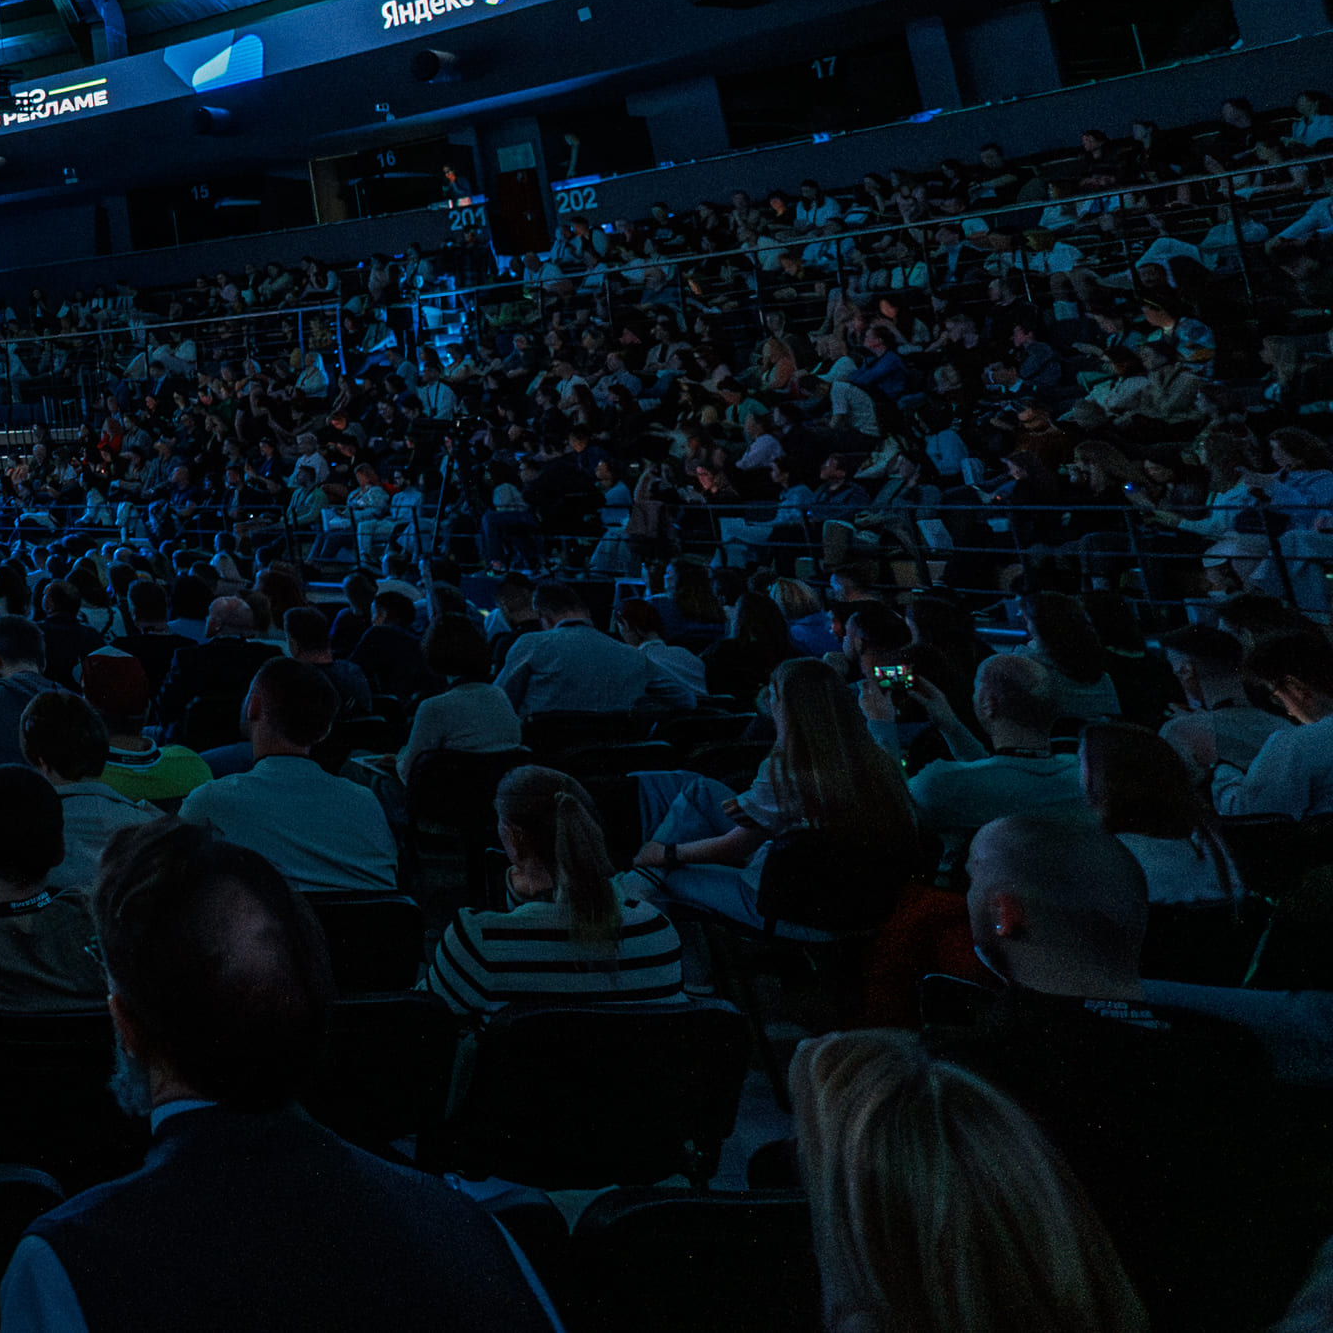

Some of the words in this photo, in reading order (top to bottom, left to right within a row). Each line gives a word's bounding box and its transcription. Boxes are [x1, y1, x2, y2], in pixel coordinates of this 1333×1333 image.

[810, 54, 838, 80] 17
[376, 150, 396, 168] 16
[190, 183, 210, 201] 15
[556, 186, 598, 214] 202
[448, 206, 486, 232] 201
